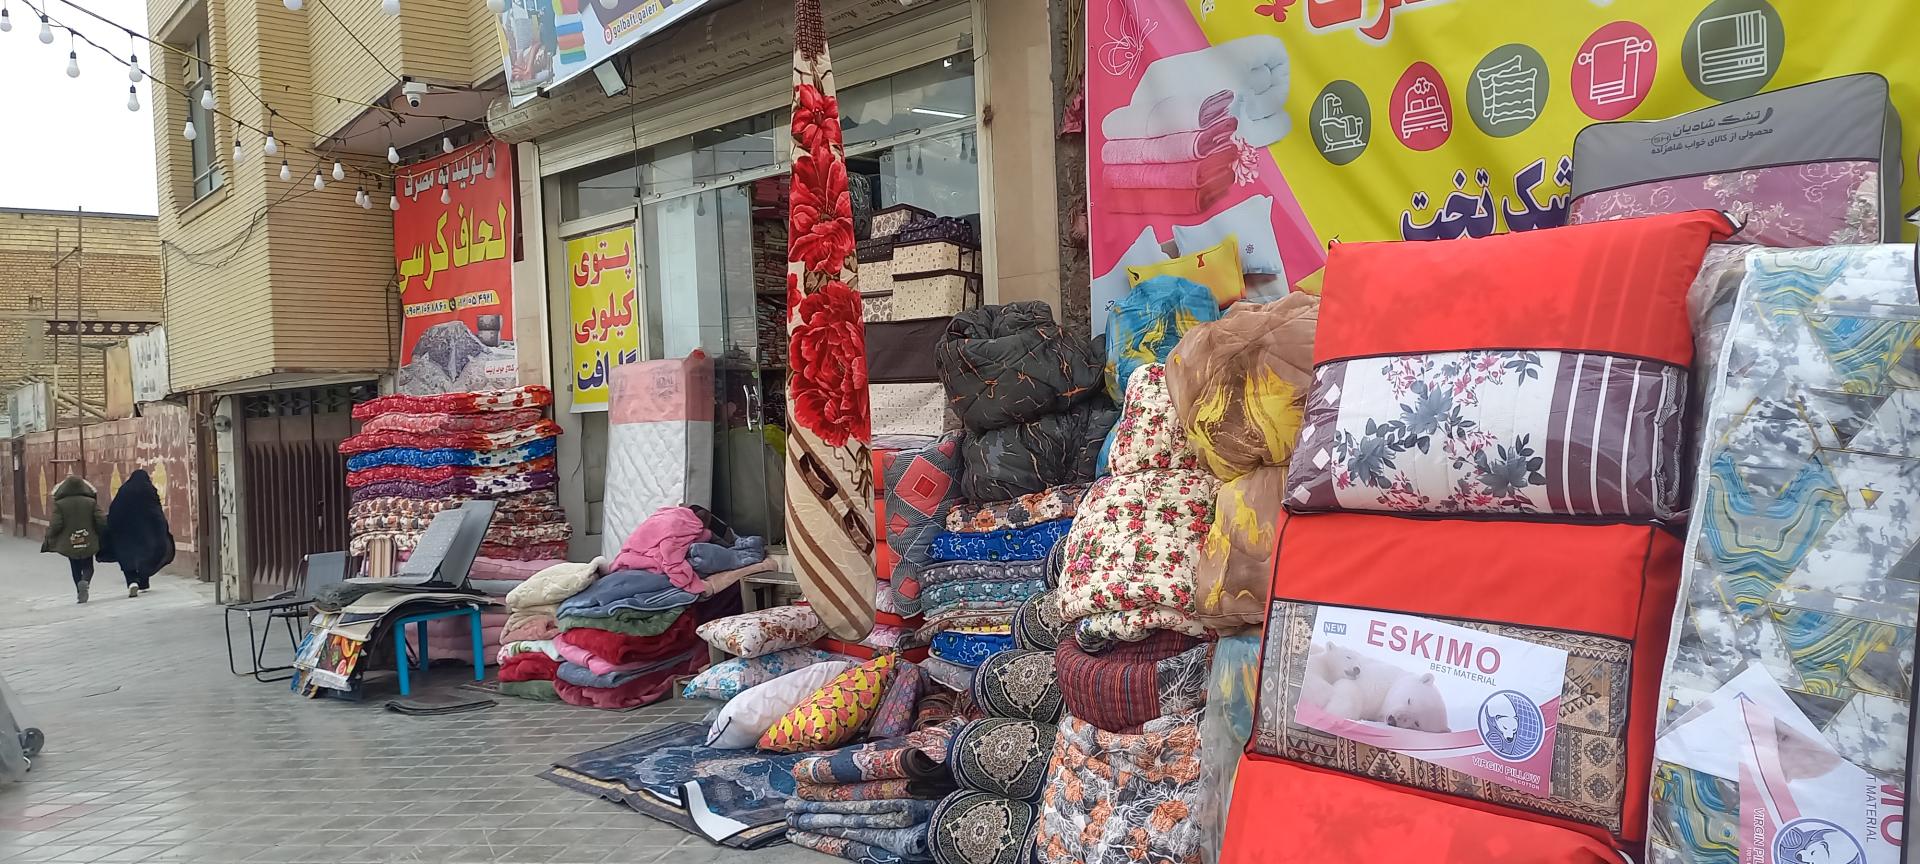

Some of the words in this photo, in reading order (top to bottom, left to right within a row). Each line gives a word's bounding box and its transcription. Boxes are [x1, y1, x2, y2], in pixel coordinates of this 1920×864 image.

[612, 2, 658, 38] golbaft.galeri
[1672, 118, 1715, 137] شادیان
[1718, 110, 1760, 126] تشک
[1738, 127, 1773, 141] محصولی
[1684, 138, 1705, 150] خواب
[1707, 134, 1727, 147] کالای
[1729, 132, 1737, 143] از
[453, 149, 483, 185] تولید
[404, 169, 434, 202] مصرف
[1501, 155, 1572, 233] شک
[1401, 169, 1497, 241] تخت
[452, 200, 507, 268] لحاف
[399, 210, 449, 295] کرسی
[574, 240, 632, 287] پتوی
[574, 289, 634, 343] کیلویی
[1324, 623, 1345, 634] NEW
[1367, 619, 1501, 674] ESKIMO
[1430, 662, 1452, 674] BEST
[1453, 668, 1497, 686] MATERIAL
[1472, 756, 1503, 774] VIRGIN
[1504, 766, 1541, 785] PILLOW
[1518, 780, 1540, 790] COTTON
[1753, 808, 1765, 846] VIRGIN
[1866, 785, 1877, 842] MATERIAL
